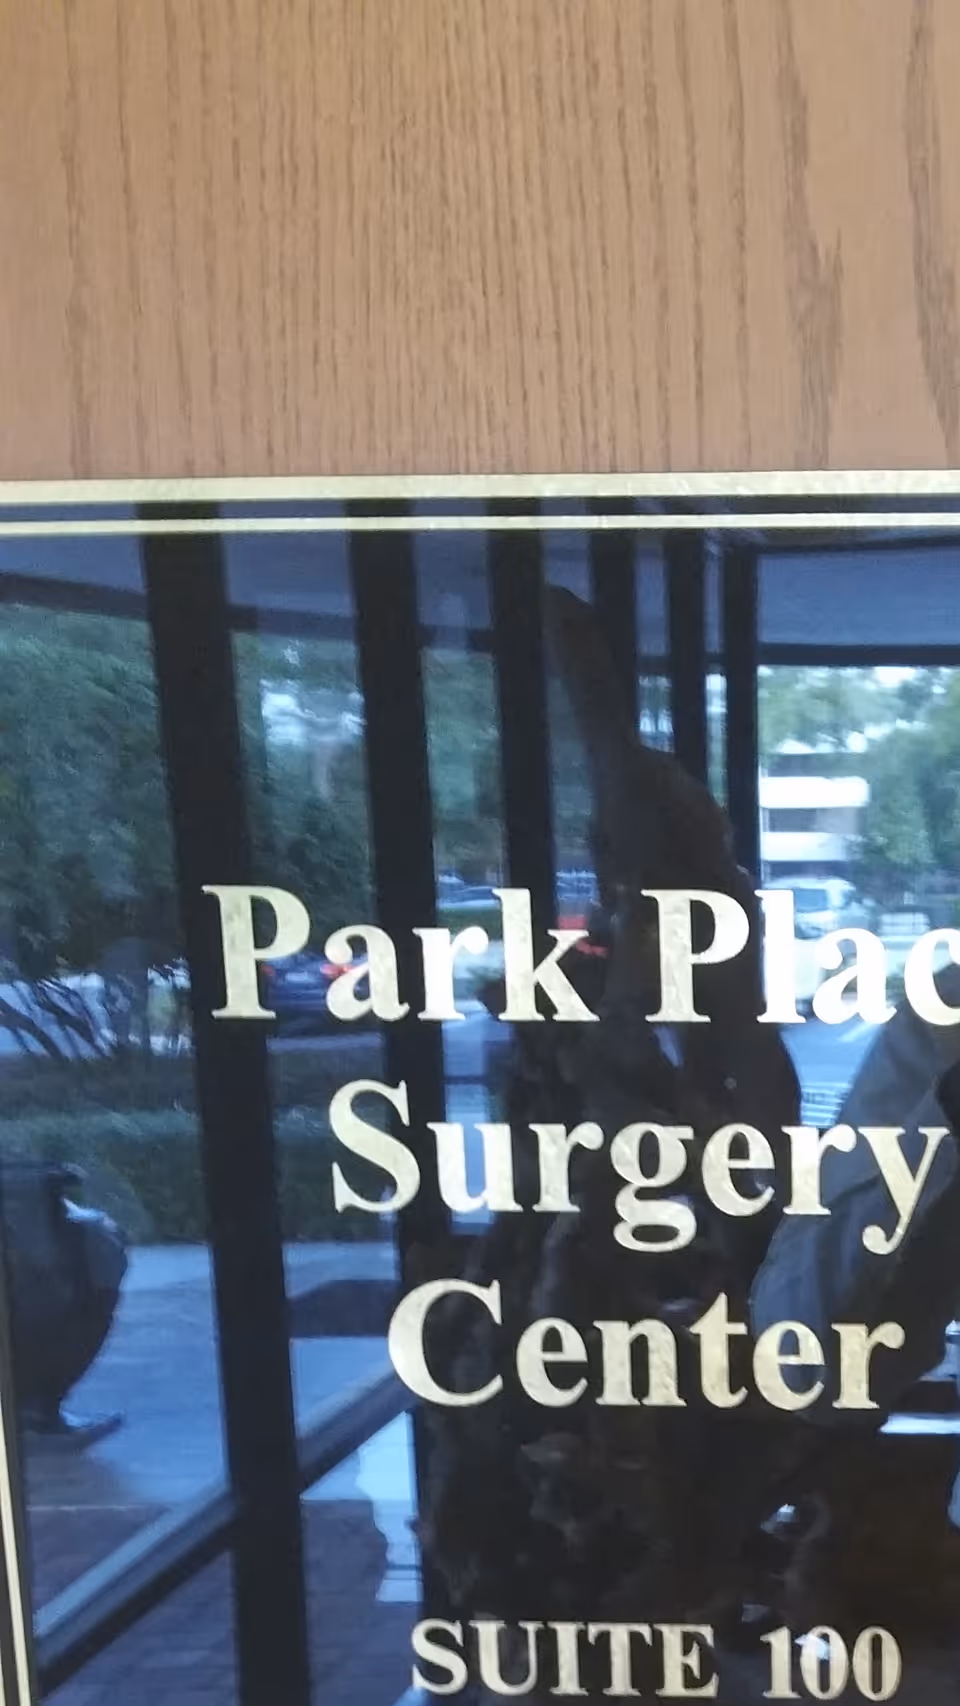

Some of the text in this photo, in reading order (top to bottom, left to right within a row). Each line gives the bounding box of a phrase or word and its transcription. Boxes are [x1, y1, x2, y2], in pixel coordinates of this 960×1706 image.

[202, 884, 598, 1025] Park
[328, 1077, 950, 1256] Surgery
[387, 1278, 906, 1409] Center
[410, 1617, 903, 1701] SUITE 100
